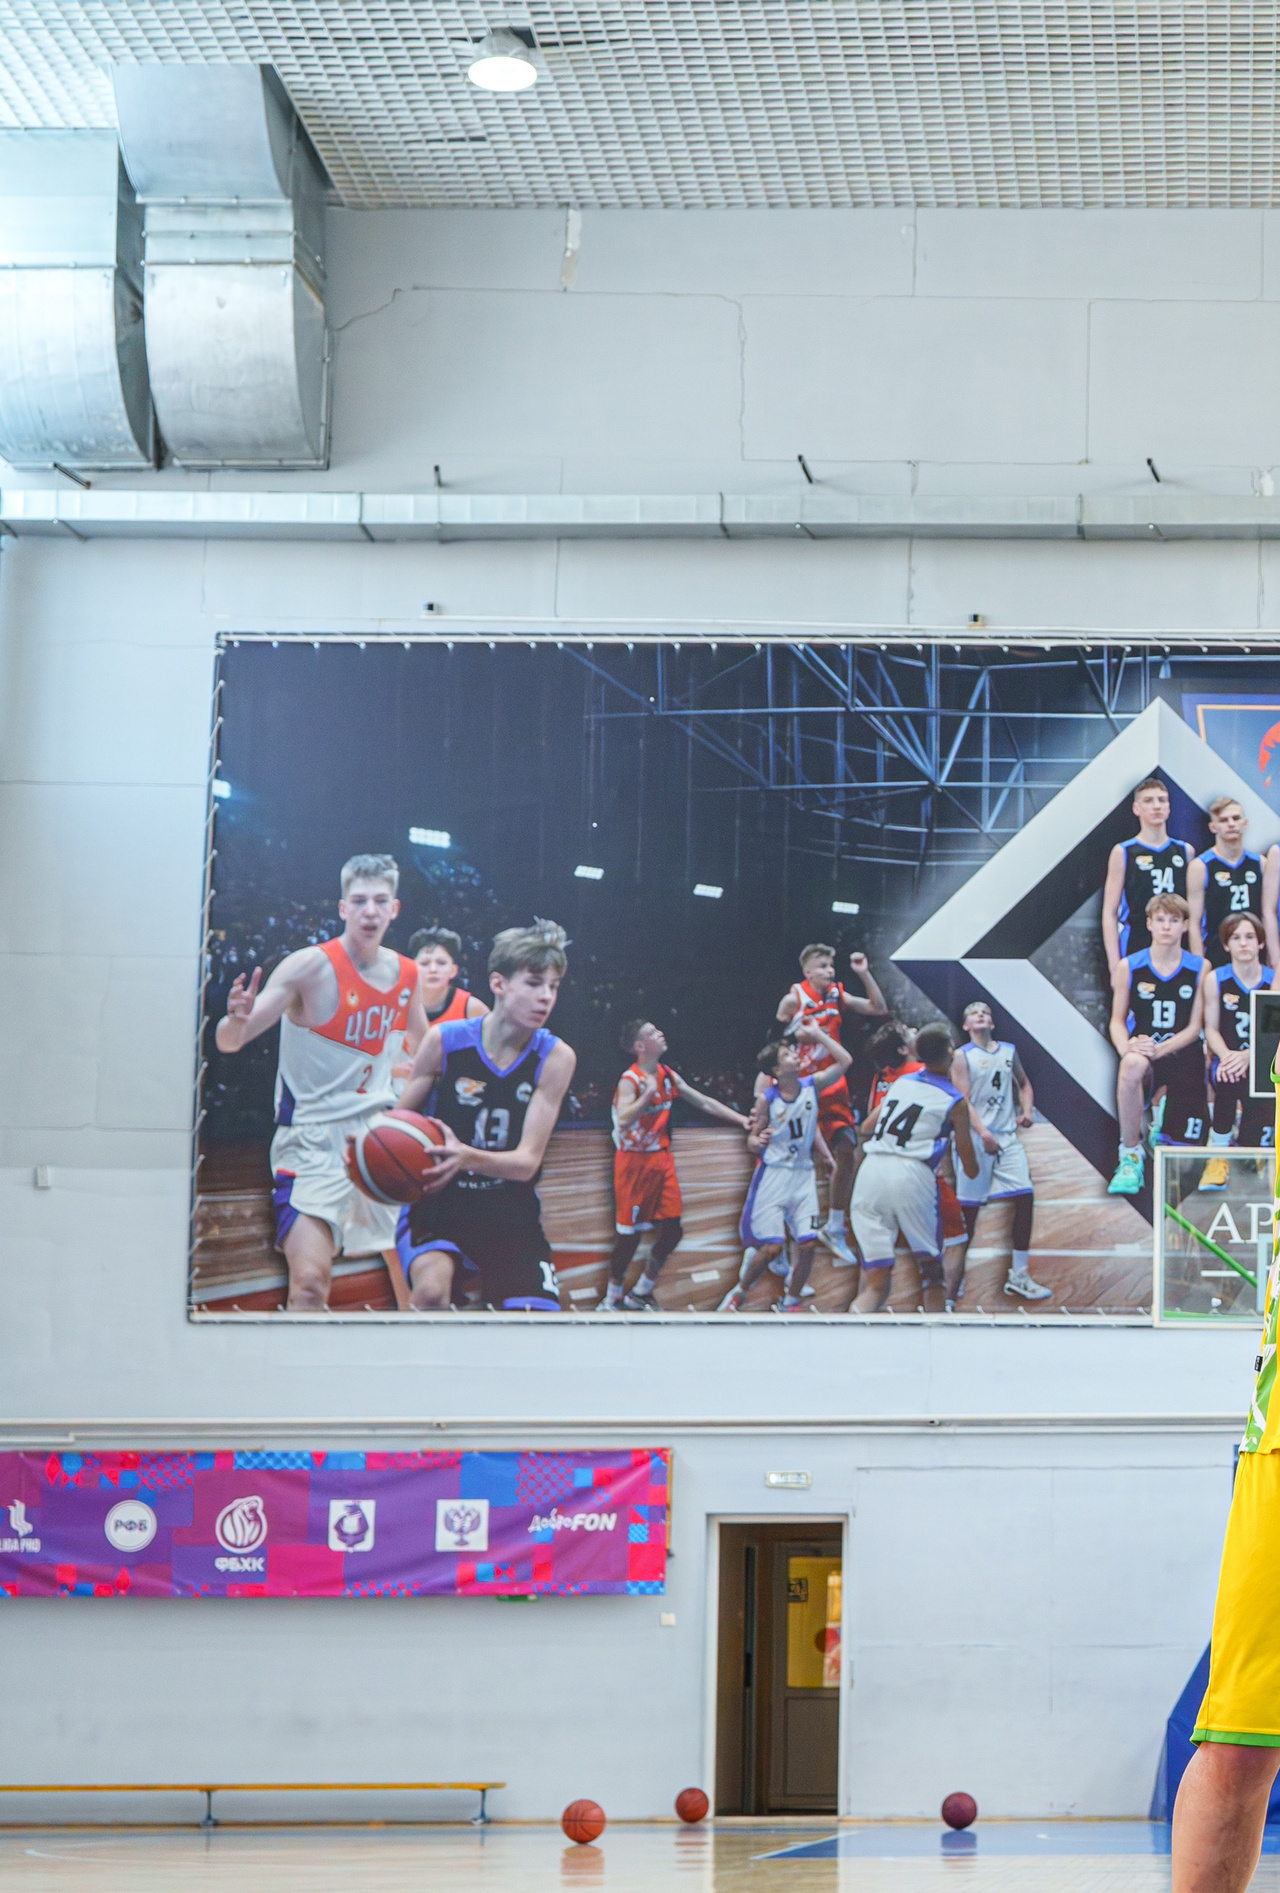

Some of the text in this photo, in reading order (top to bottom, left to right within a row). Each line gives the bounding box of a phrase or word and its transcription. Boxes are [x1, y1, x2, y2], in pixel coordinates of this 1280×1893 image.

[1151, 867, 1175, 895] 34
[1230, 884, 1250, 911] 23
[1152, 1000, 1176, 1029] 13
[1235, 1011, 1250, 1038] 2
[991, 1070, 1002, 1091] 4
[471, 1107, 511, 1150] 13
[1184, 1117, 1203, 1139] 13
[114, 1519, 148, 1532] РФБ
